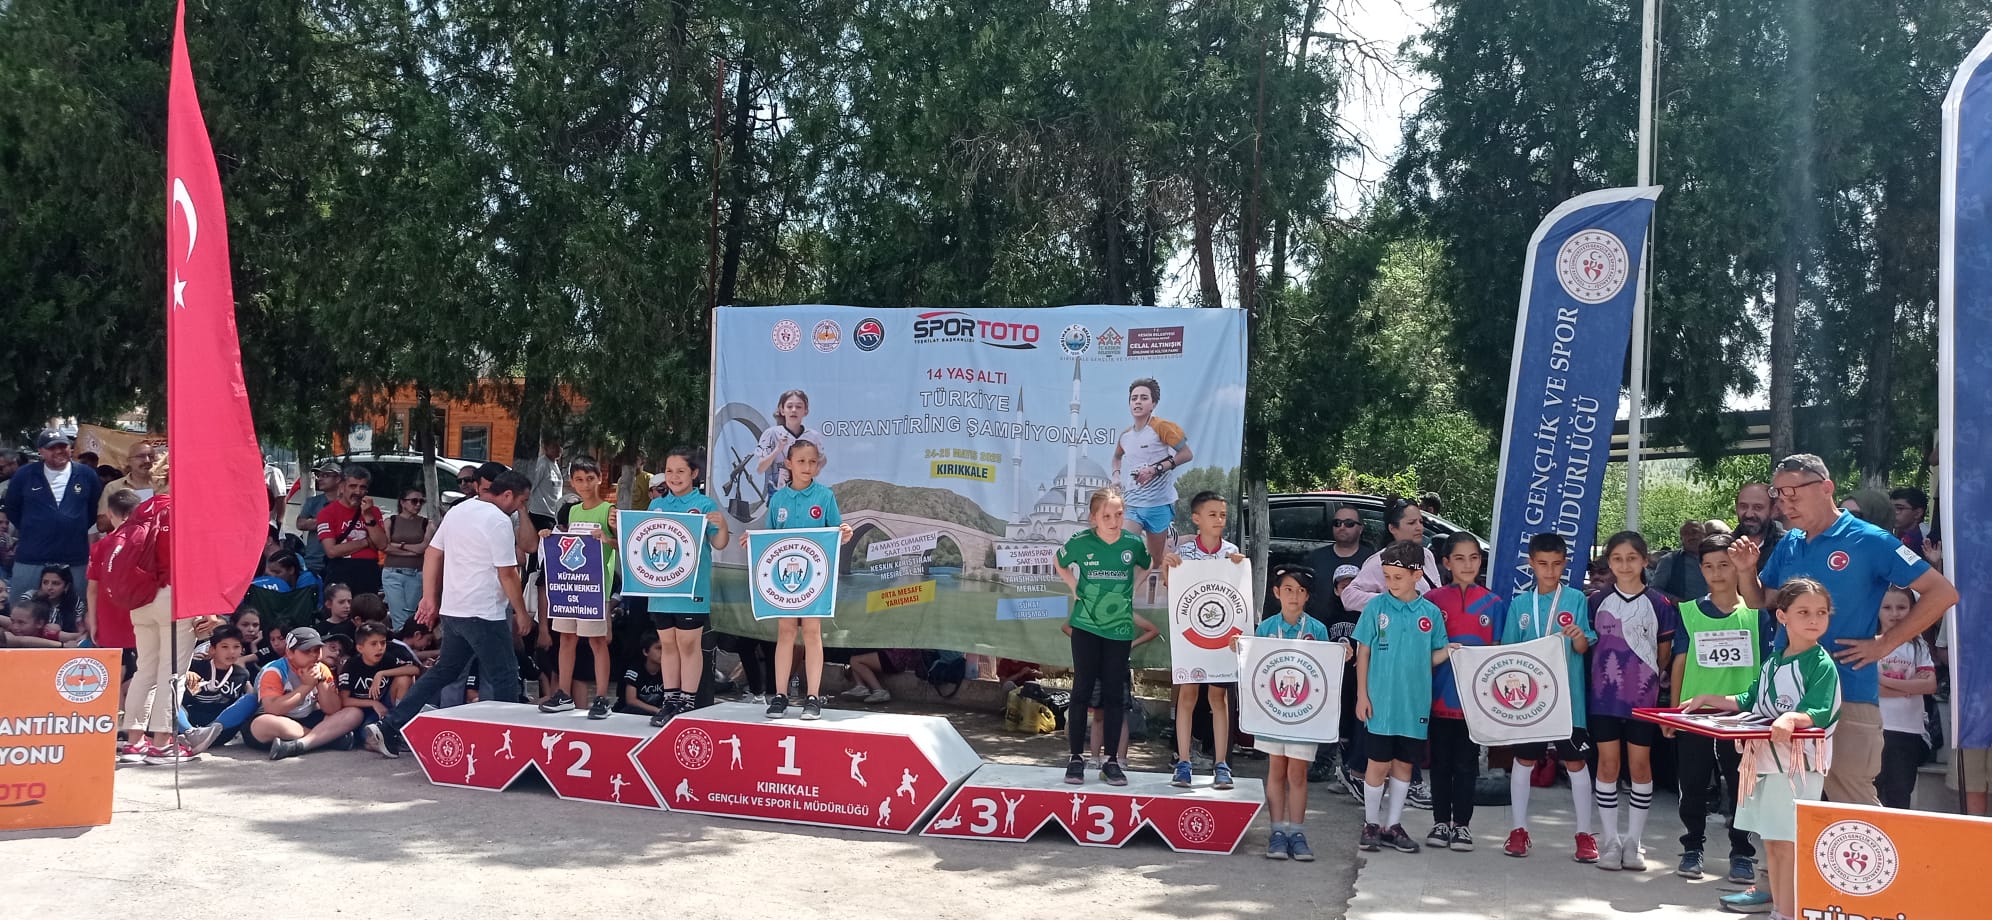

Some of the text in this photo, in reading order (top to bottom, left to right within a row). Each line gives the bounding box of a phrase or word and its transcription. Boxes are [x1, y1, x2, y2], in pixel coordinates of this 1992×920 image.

[1550, 307, 1579, 372] SPOR
[927, 367, 1007, 385] 14 YAŞ ALTI
[920, 387, 1010, 412] TÜRKİYE
[1543, 376, 1567, 408] VE
[822, 414, 1116, 445] ORYANTİRİNG ŞAMPİYONASI
[936, 463, 989, 479] KIRIKKALE
[1525, 413, 1560, 525] GENÇLİK
[636, 523, 689, 544] BAŞKENT HEDEF
[871, 532, 936, 552] 24 MAYIS CUMARTESİ
[766, 544, 821, 564] BAŞKENT HEDEF
[904, 544, 921, 553] 11.00
[1035, 549, 1053, 557] PAZAR
[557, 572, 590, 580] KÜTAHYA
[636, 566, 685, 582] SPOR KULÜBÜ
[549, 582, 601, 593] GENÇLİK MERKEZİ
[766, 587, 815, 604] SPOR KULÜBÜ
[881, 585, 923, 600] ORTA MESAFE
[1016, 583, 1047, 593] MERKEZİ
[567, 595, 579, 603] GSK
[885, 595, 919, 607] YARIŞMASI
[1181, 583, 1243, 616] MUĞLA ORYANTİRİNG
[553, 605, 598, 615] ORYANTİRİNG
[1709, 647, 1741, 662] 493
[1263, 656, 1319, 679] BAŞKENT HEDEF
[1481, 659, 1544, 683] BAŞKENT HEDEF
[1264, 699, 1313, 718] SPOR KULÜBÜ
[1491, 701, 1547, 720] SPOR KULÜBÜ
[566, 741, 592, 778] 2
[776, 735, 801, 776] 1
[757, 781, 819, 798] KIRIKKALE
[707, 792, 869, 816] GENÇLİK VE SPOR İL MÜDÜRLÜĞÜ
[970, 798, 998, 834] 3
[1086, 806, 1115, 842] 3
